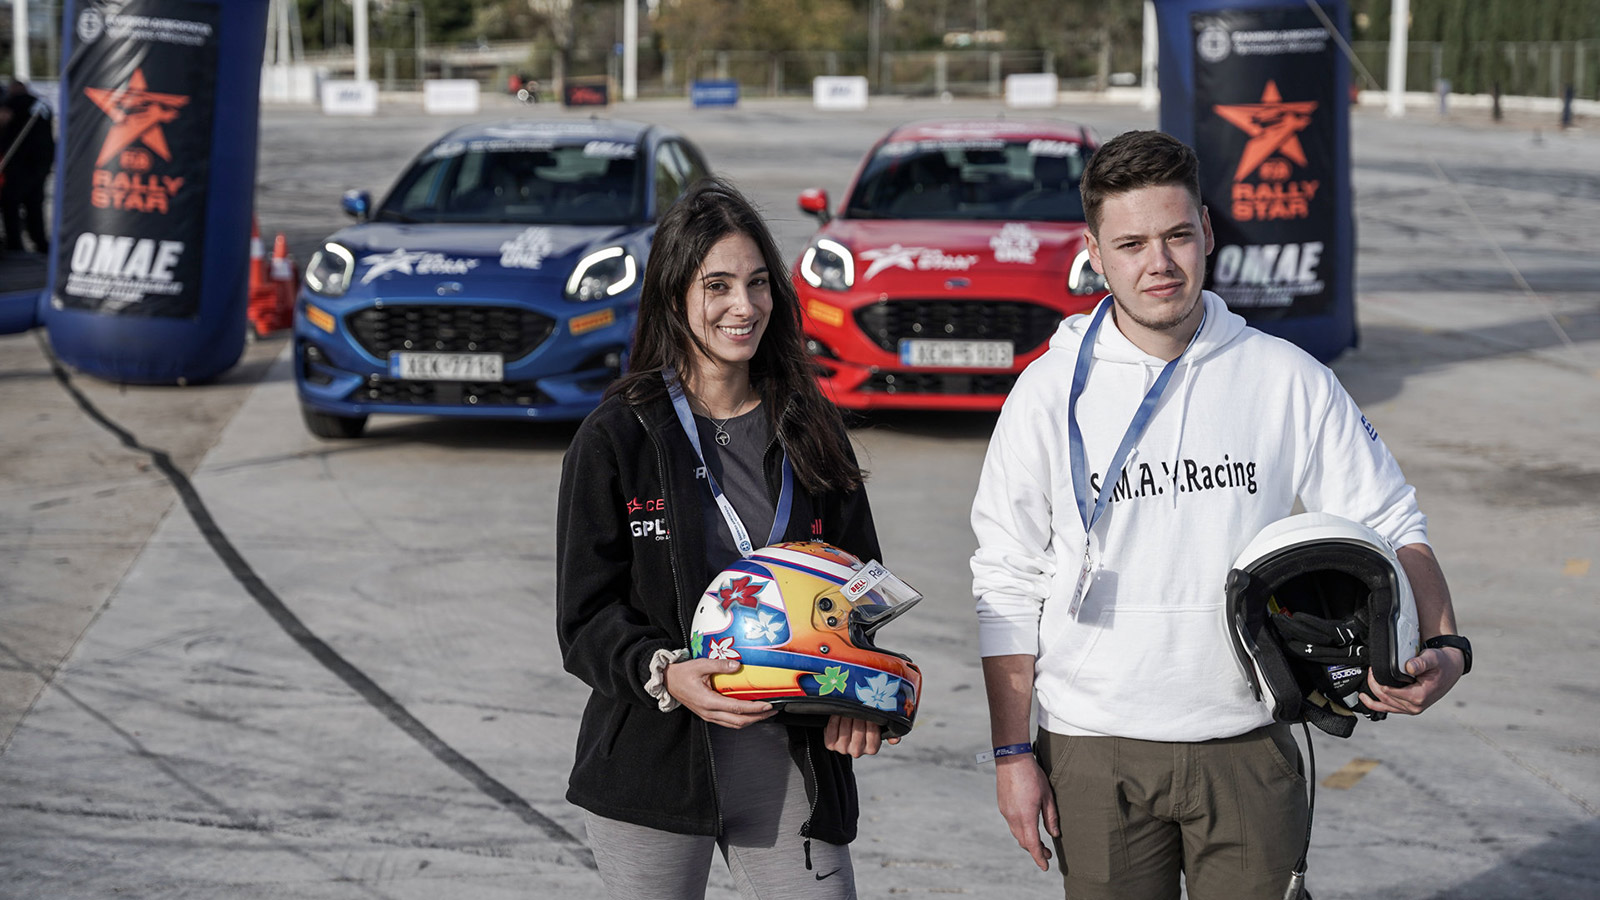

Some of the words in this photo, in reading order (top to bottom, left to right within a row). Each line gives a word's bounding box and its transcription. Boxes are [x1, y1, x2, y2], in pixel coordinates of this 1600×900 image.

[92, 170, 184, 196] RALLY
[1232, 180, 1320, 201] RALLY
[91, 187, 169, 214] STAR
[1232, 198, 1309, 221] STAR
[71, 232, 185, 281] OMAE
[1214, 241, 1324, 284] OMAE
[850, 579, 867, 593] BELL
